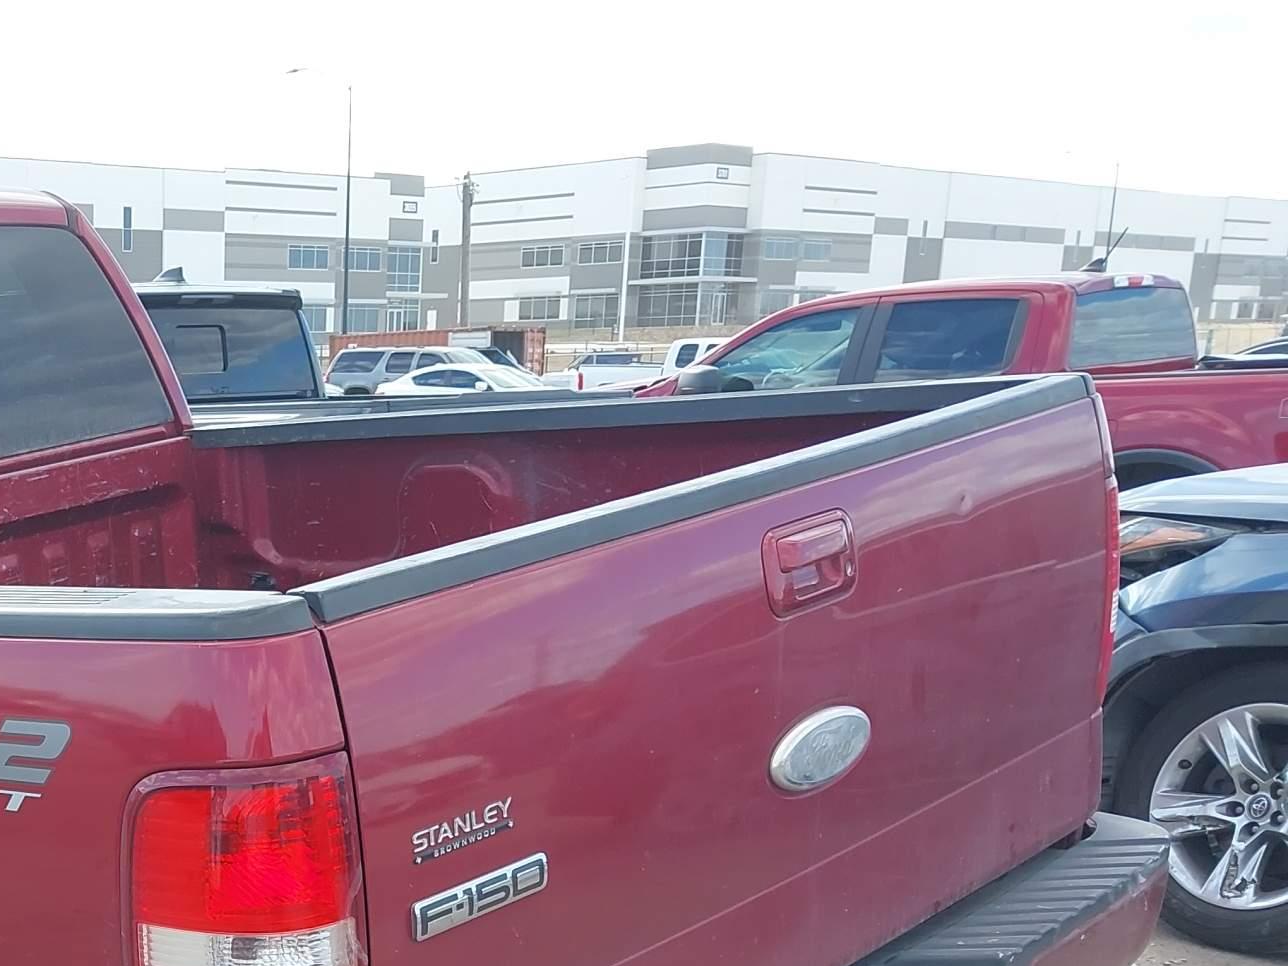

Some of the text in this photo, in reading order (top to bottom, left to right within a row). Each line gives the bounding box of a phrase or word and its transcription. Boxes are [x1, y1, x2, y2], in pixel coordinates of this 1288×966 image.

[412, 796, 513, 854] STANLEY
[433, 826, 496, 858] BROWNWOOD
[418, 857, 546, 938] F-150
